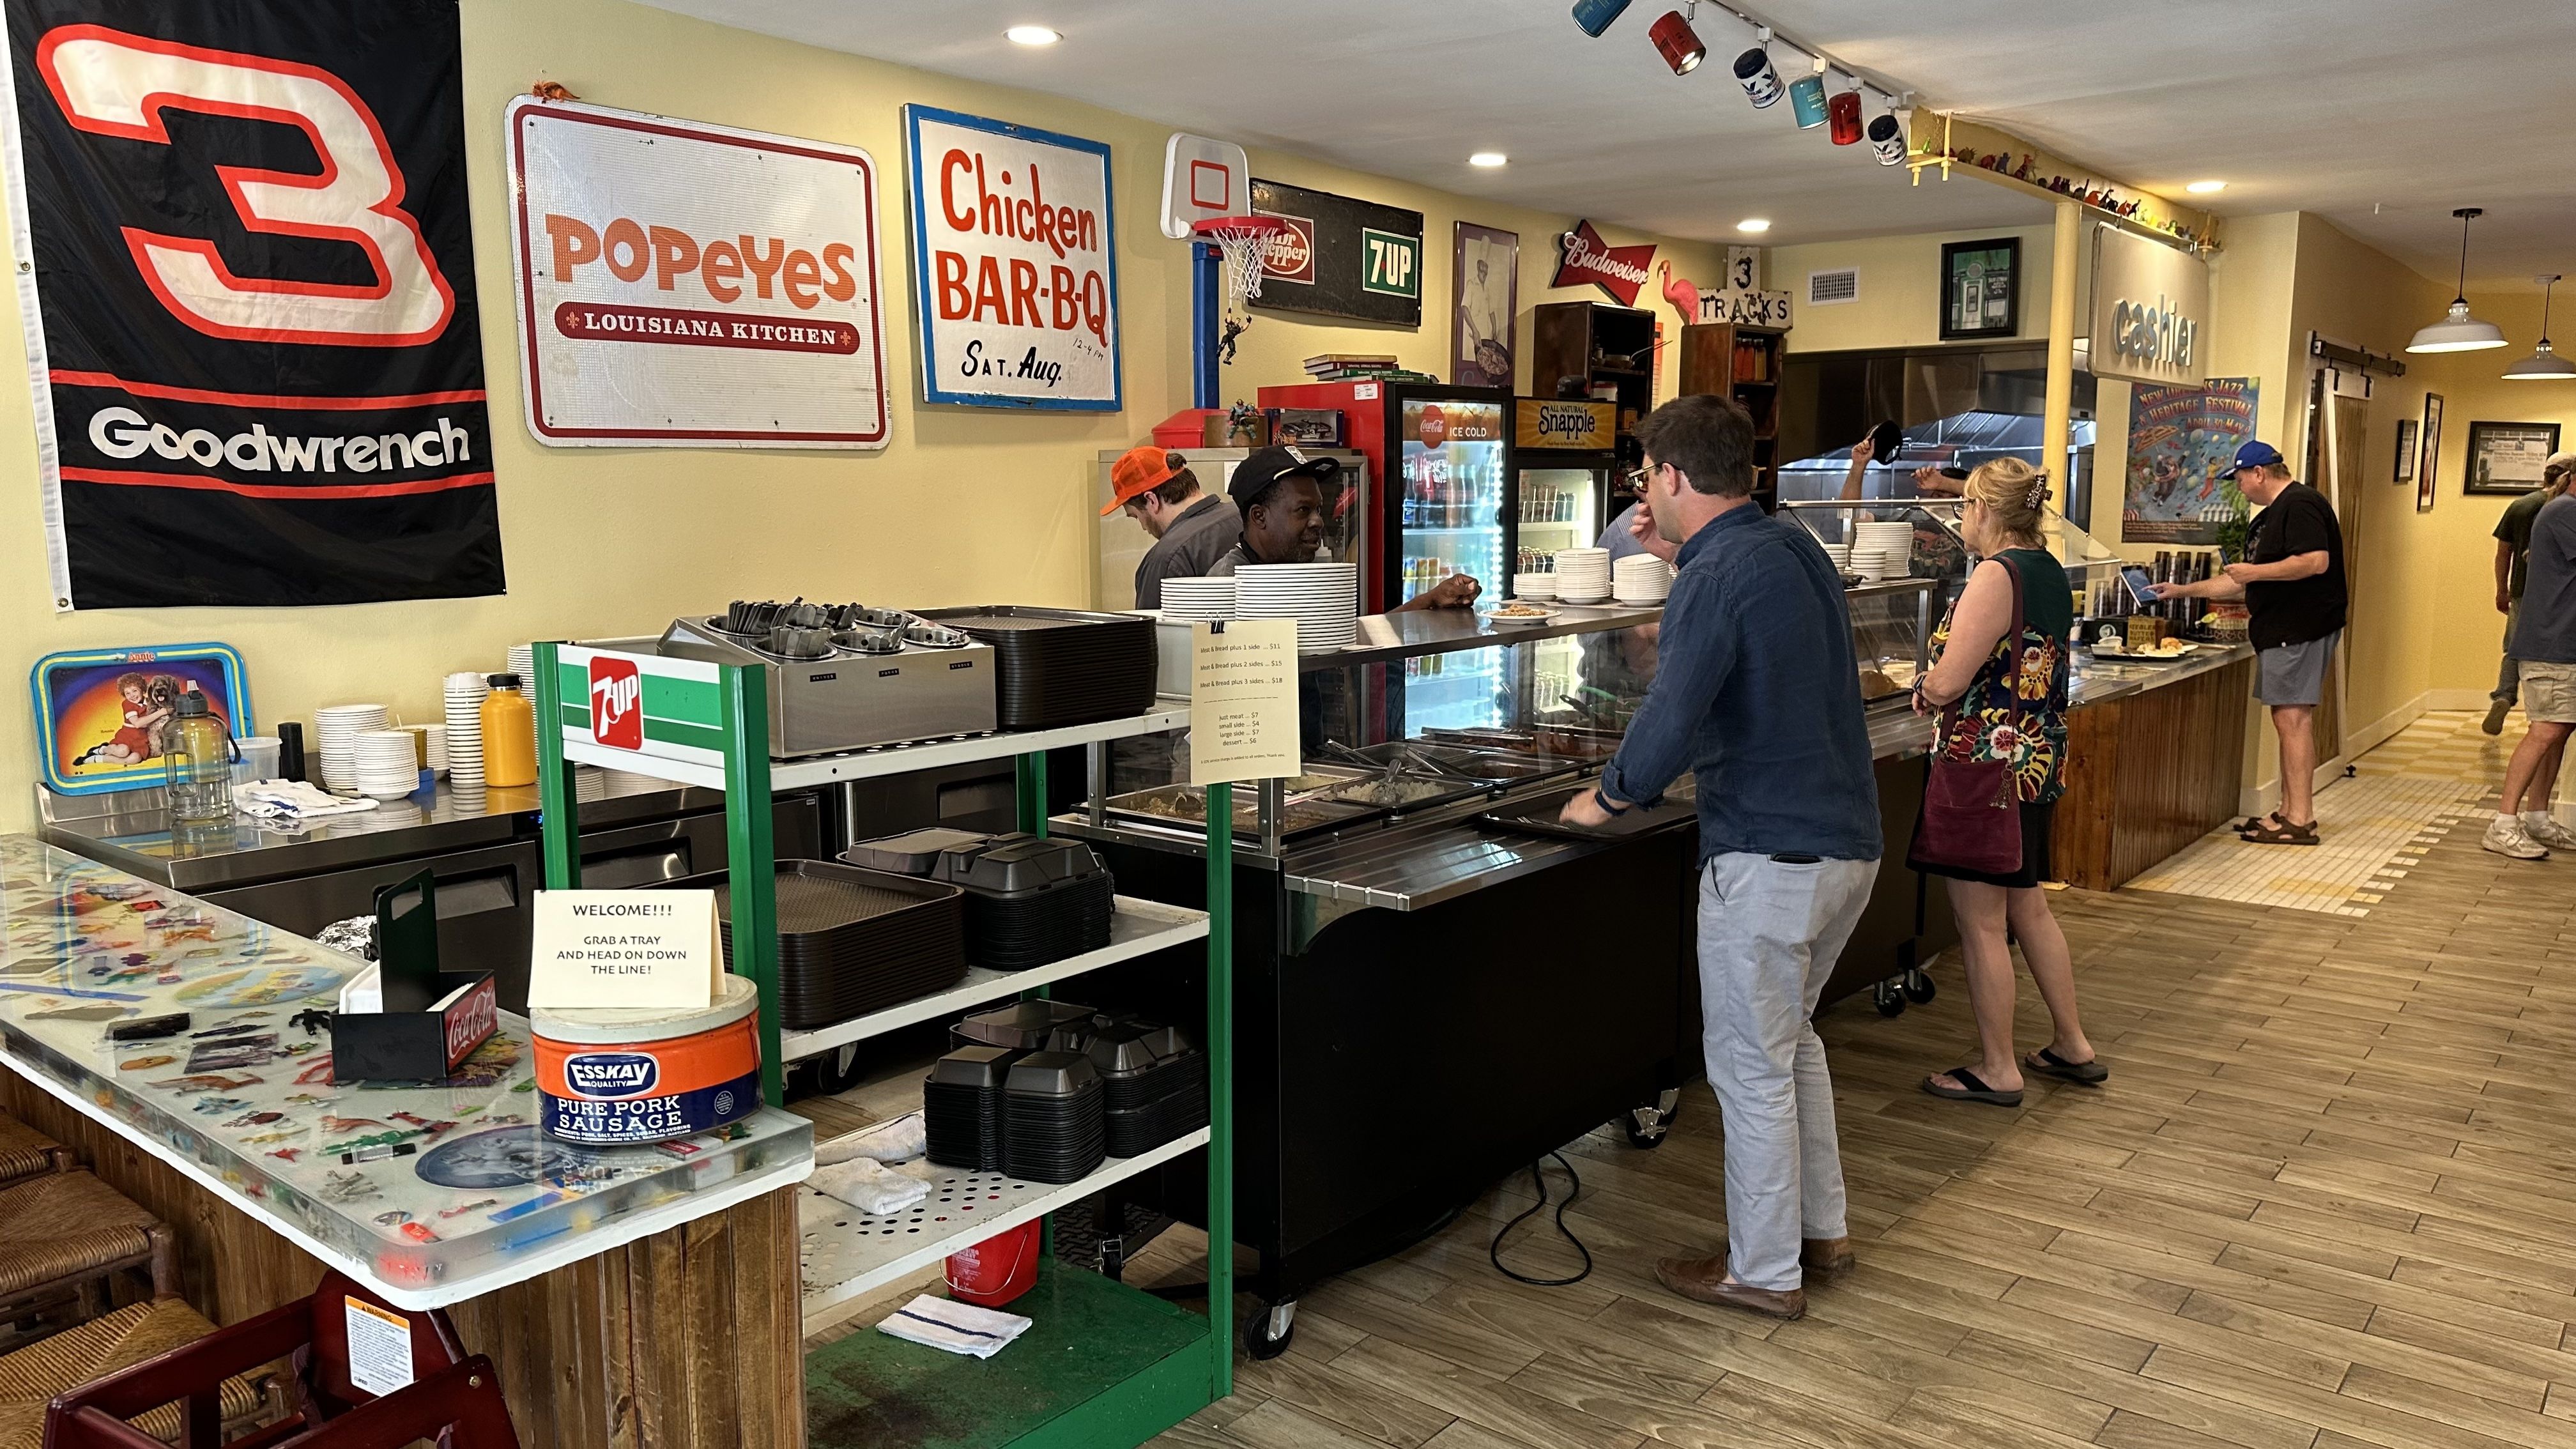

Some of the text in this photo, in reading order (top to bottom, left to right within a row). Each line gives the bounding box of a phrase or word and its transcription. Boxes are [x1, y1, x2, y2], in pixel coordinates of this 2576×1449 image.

[37, 24, 454, 346] 3
[940, 149, 1096, 259] Chicken
[1563, 234, 1648, 284] Budweiser
[1734, 257, 1752, 289] 3
[1700, 296, 1788, 321] TRACKS
[585, 312, 836, 345] LOUISIANA KITCHEN
[2114, 293, 2198, 367] cashier
[1073, 337, 1092, 355] 12-4
[1017, 346, 1062, 387] Aug.
[2139, 389, 2163, 408] NEW
[2216, 379, 2244, 395] JAZZ
[1560, 405, 1583, 413] NATURAL
[2149, 398, 2199, 422] HERITAGE
[2205, 396, 2253, 419] FESTIVAL
[1450, 427, 1487, 437] ICE COLD
[1538, 406, 1595, 440] Snapple
[2186, 417, 2210, 430] APRIL
[89, 407, 470, 473] Goodwrench
[129, 652, 155, 661] Annie
[592, 674, 638, 739] 7UP
[573, 905, 672, 916] WELCOME!!!
[584, 936, 661, 945] GRAB A TRAY
[557, 951, 687, 960] AND HEAD ON DOWN
[591, 965, 652, 974] THE LINE!
[570, 1062, 650, 1086] ESSKAY
[590, 1080, 627, 1088] QUALITY
[558, 1095, 680, 1116] PURE PORK
[560, 1111, 682, 1132] SAUSAGE
[659, 1124, 691, 1133] FLAVORING
